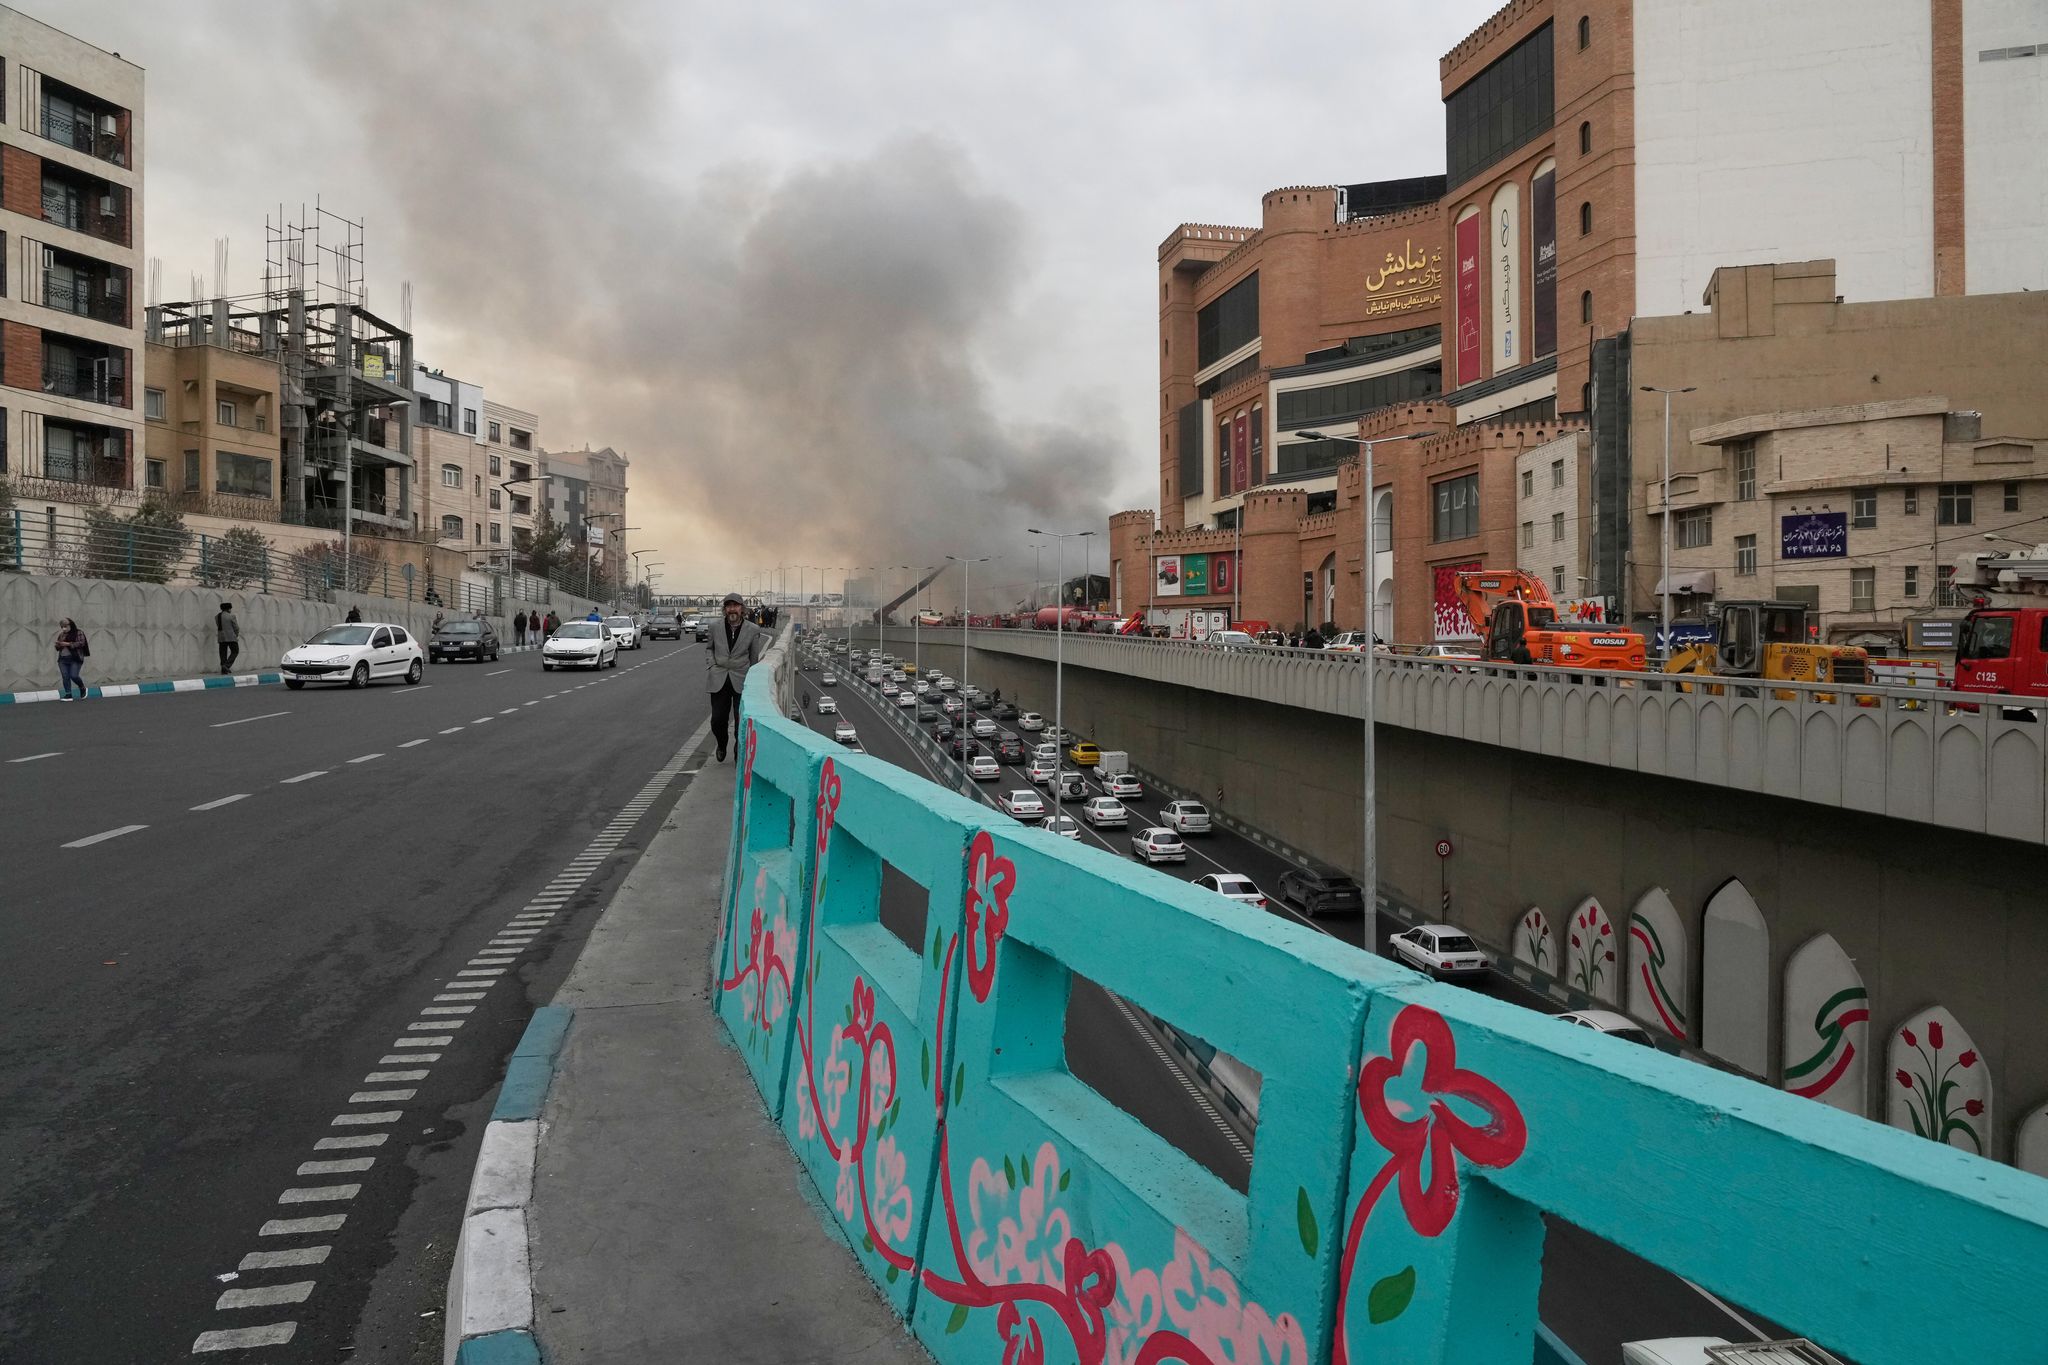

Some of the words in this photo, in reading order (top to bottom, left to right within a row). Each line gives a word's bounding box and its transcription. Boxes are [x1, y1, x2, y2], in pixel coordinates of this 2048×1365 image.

[1366, 238, 1427, 292] نیایش
[1366, 301, 1390, 315] نیایش
[1389, 298, 1401, 311] بام
[1816, 544, 1828, 553] ۸۸
[1830, 544, 1842, 553] ۶۵
[1789, 646, 1811, 654] XGMA
[1976, 672, 1997, 682] C125
[1440, 844, 1448, 853] 60
